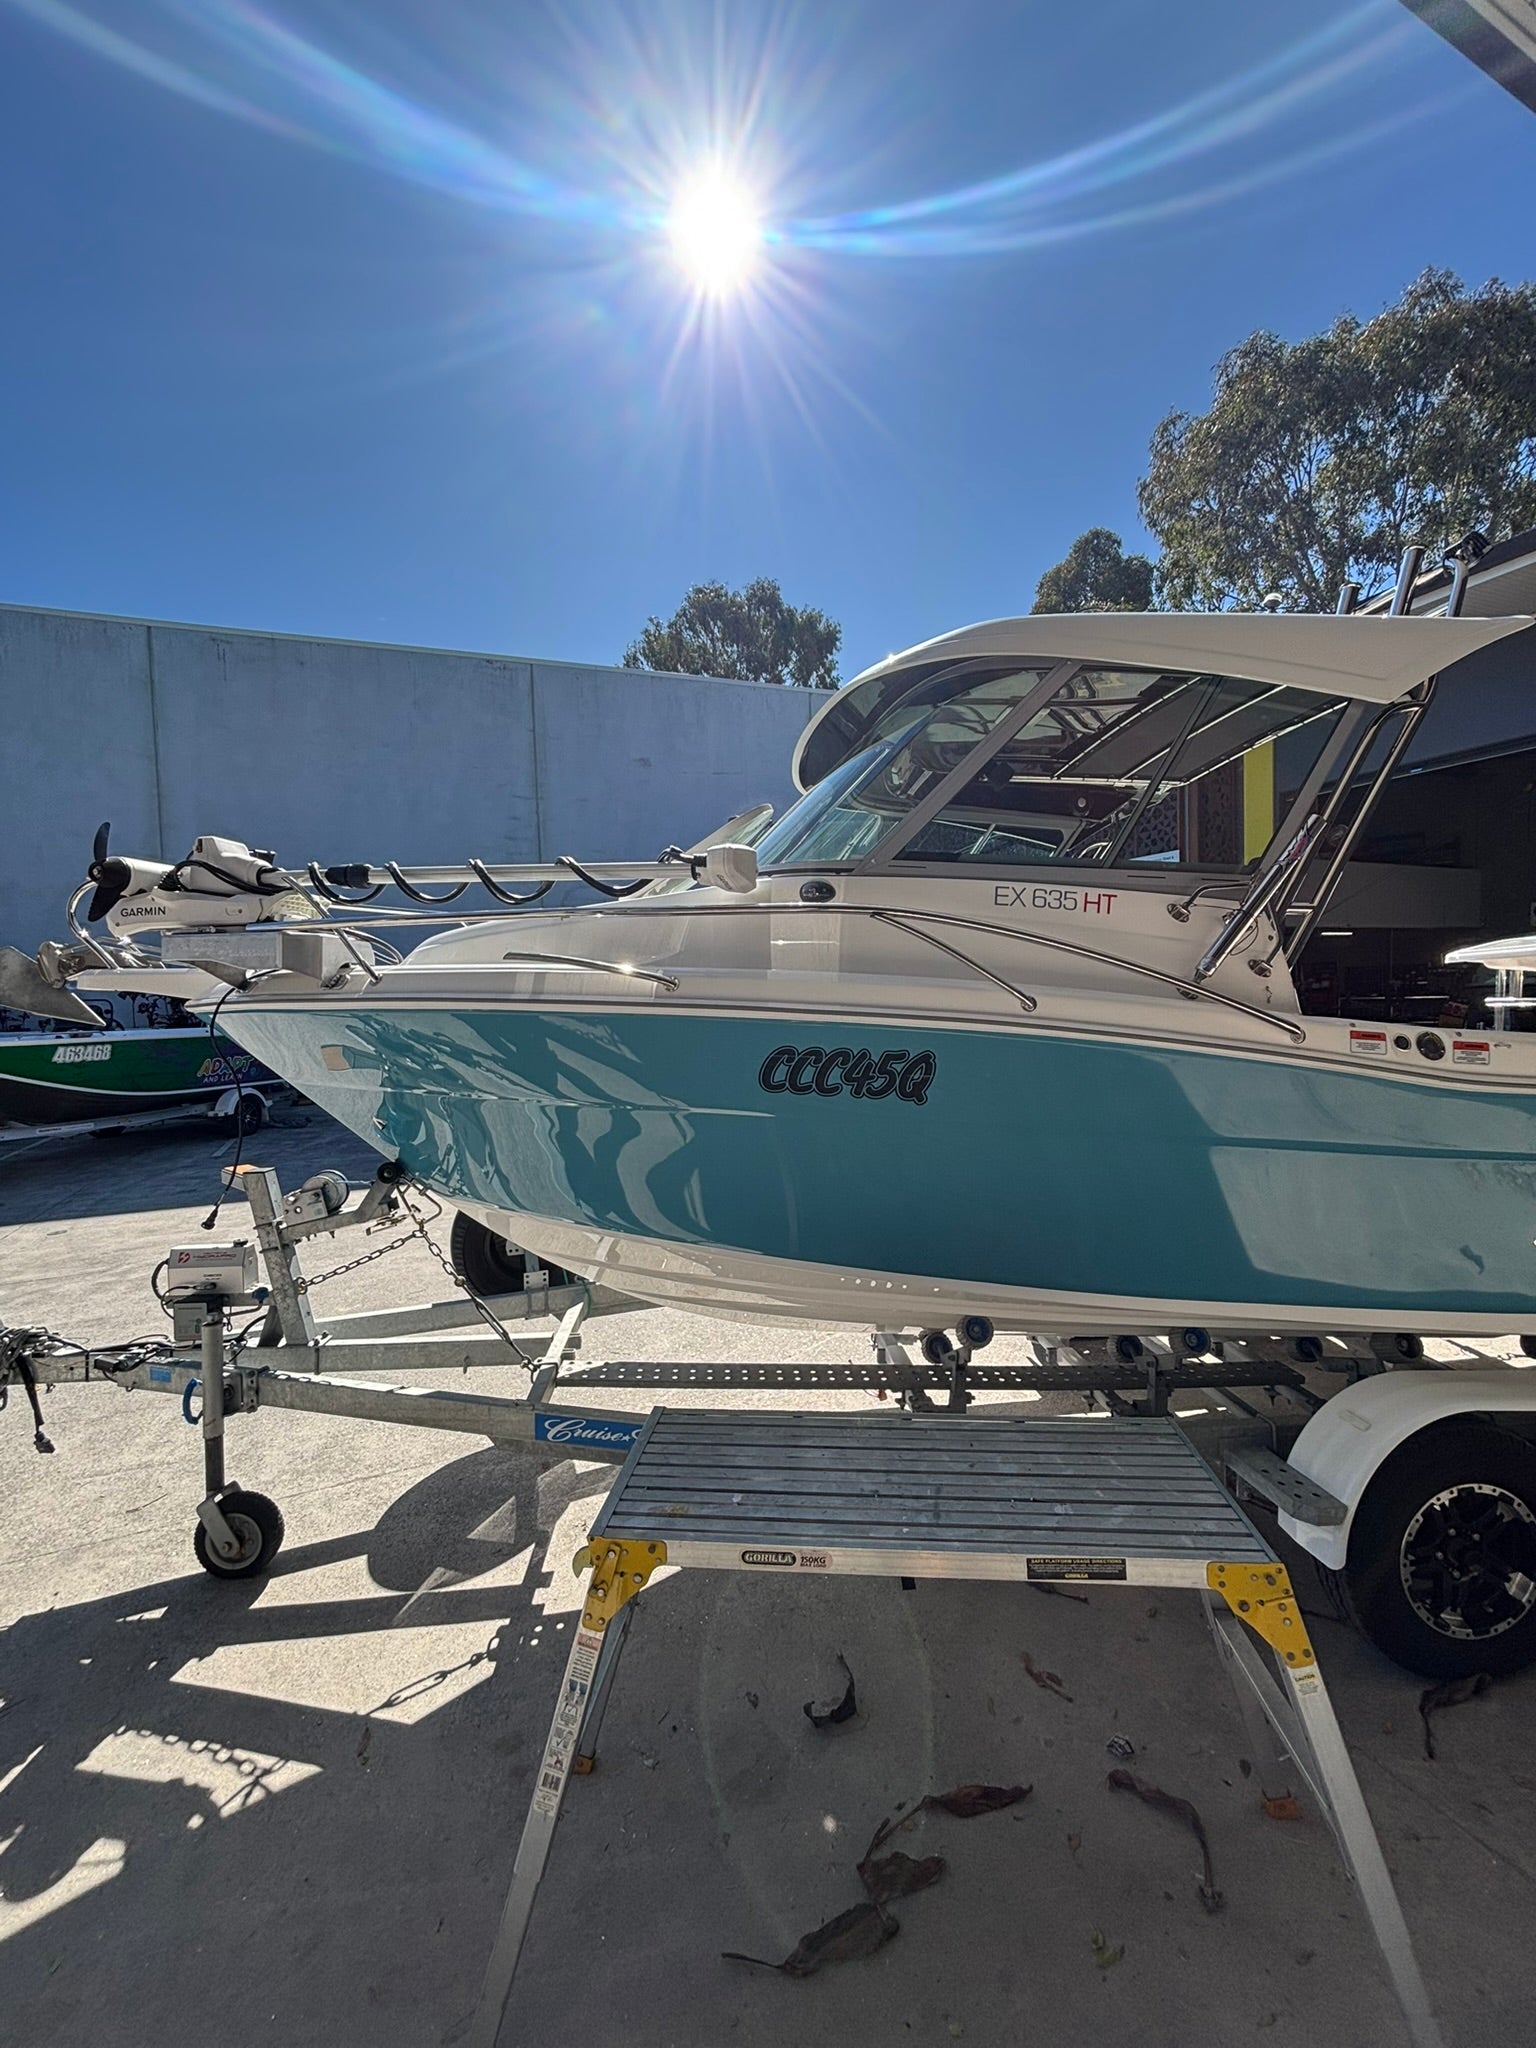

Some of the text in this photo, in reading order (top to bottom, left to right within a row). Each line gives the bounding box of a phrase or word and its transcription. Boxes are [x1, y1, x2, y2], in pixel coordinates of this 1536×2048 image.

[994, 885, 1118, 915] EX 635 HT
[120, 906, 166, 917] GARMIN
[52, 1044, 112, 1064] 463468
[197, 1056, 254, 1077] ADAPT
[203, 1073, 243, 1083] AND LEAN
[758, 1045, 937, 1105] CCC45Q
[745, 1552, 793, 1564] GORILLA
[800, 1555, 827, 1565] 150KG
